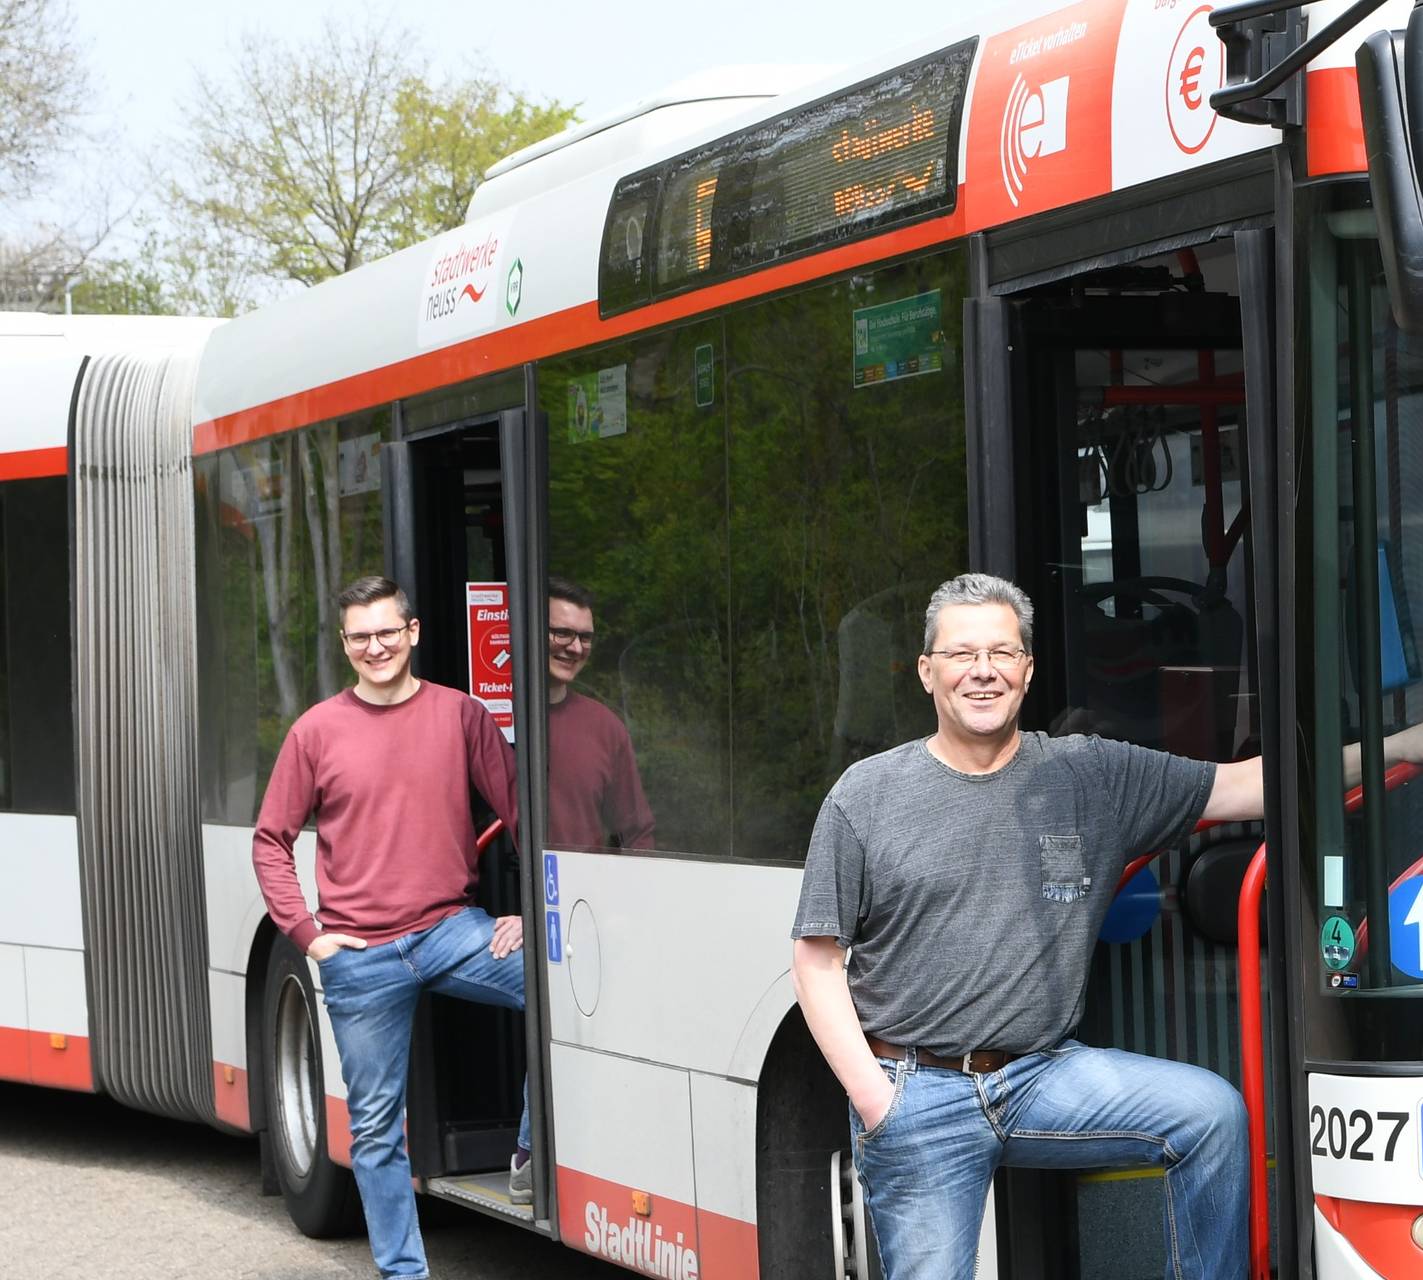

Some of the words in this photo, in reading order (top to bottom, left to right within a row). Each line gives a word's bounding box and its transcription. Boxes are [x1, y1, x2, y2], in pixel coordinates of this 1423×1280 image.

[430, 231, 498, 287] stadtwerke
[425, 286, 457, 321] neuss
[476, 608, 509, 622] Einsti
[1331, 919, 1342, 944] 4
[1310, 1105, 1410, 1163] 2027
[584, 1200, 699, 1280] StadtLinie
